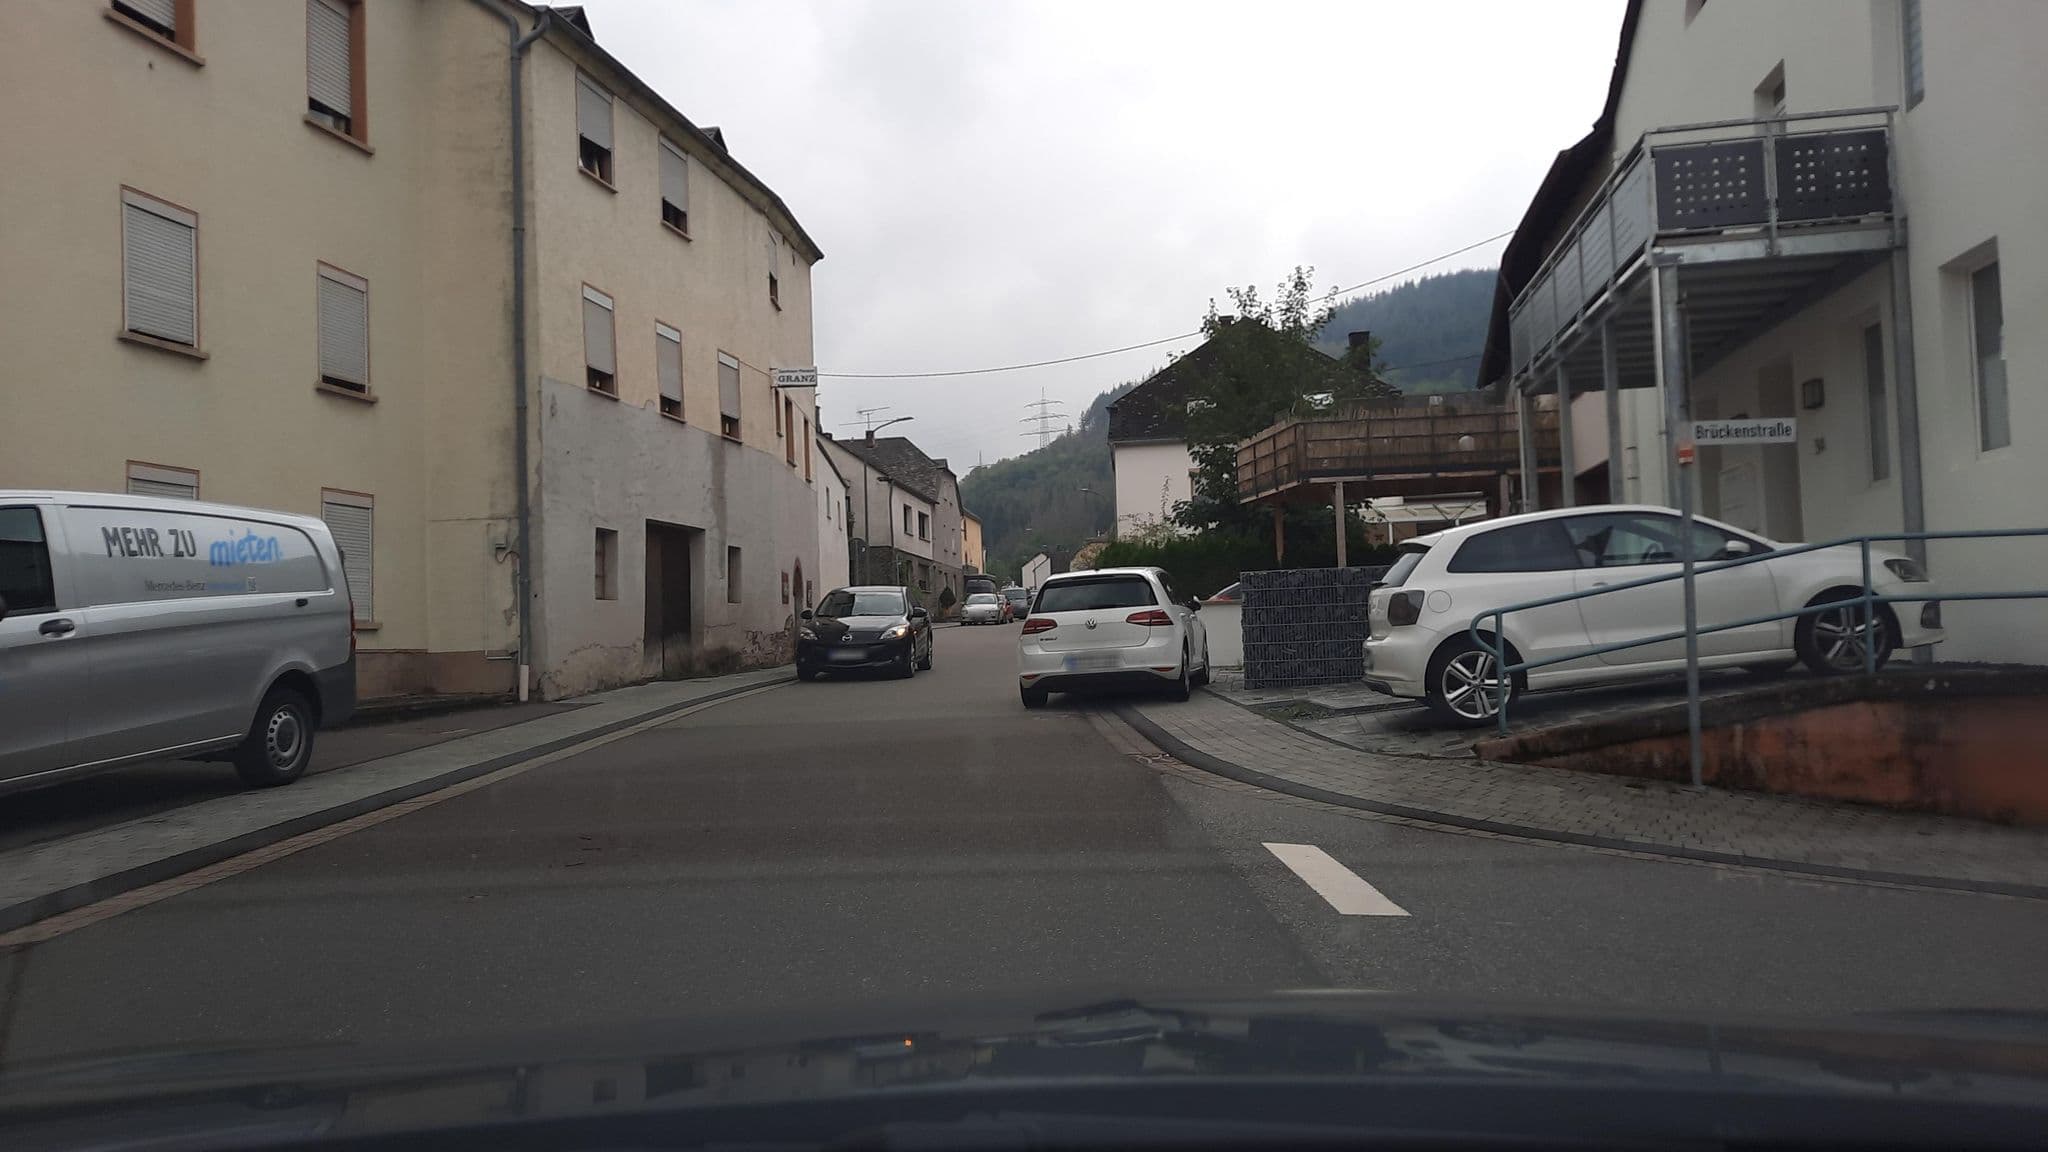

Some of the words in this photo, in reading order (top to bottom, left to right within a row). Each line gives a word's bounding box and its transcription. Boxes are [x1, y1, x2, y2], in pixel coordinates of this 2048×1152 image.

[1695, 422, 1793, 439] Brückenstraße
[102, 526, 164, 558] MEHR
[168, 528, 197, 557] ZU
